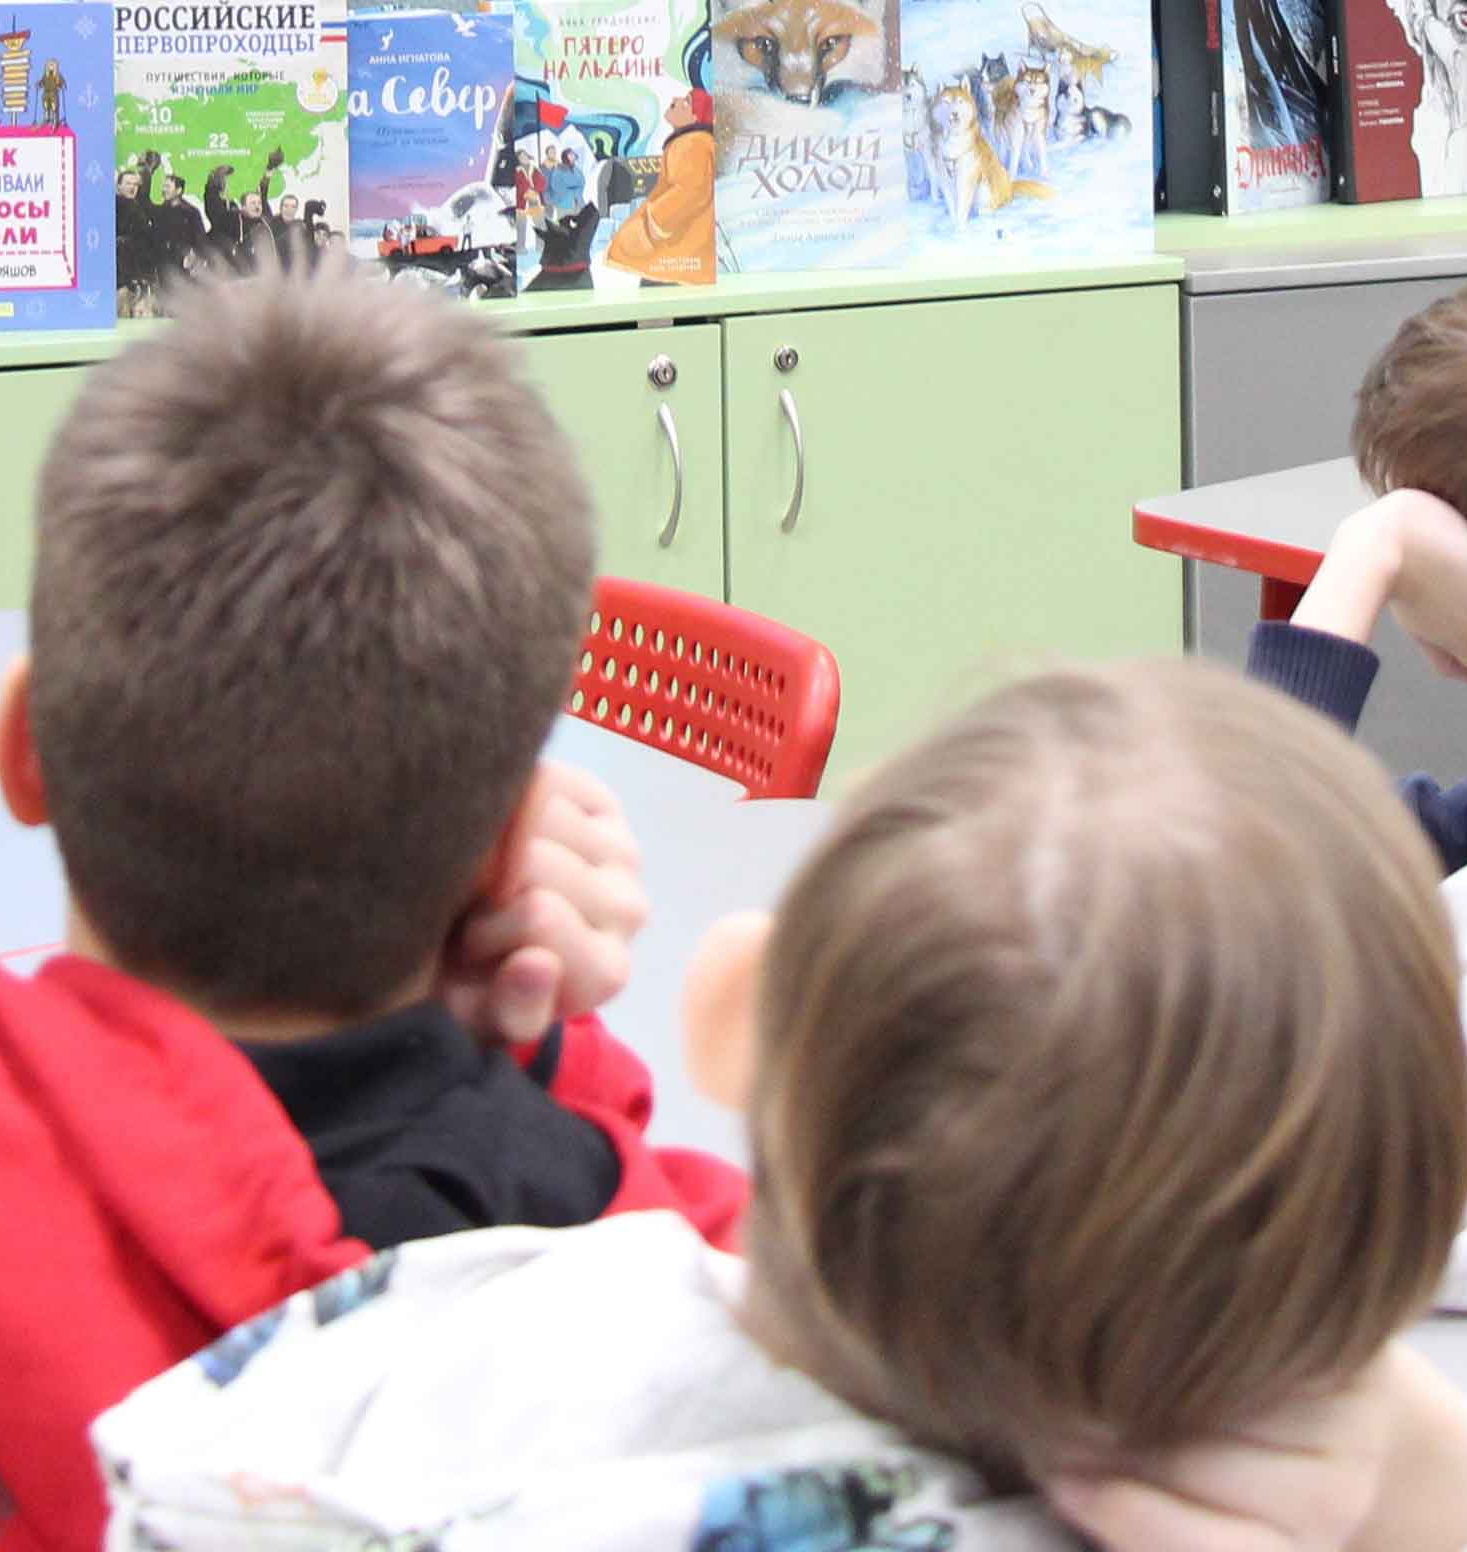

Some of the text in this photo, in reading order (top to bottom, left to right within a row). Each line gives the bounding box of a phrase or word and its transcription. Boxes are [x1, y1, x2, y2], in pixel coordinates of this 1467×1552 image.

[114, 0, 317, 32] РОССИЙСКИЕ
[116, 33, 316, 57] ПЕРВОПРОХОДЦЫ
[563, 34, 645, 57] ПЯТЕРО
[368, 51, 452, 65] АННА ИГНАТОВА
[543, 56, 666, 81] НА ЛЬДИНЕ
[145, 68, 286, 85] ПУТЕШЕСТВИЯ, КОТОРЫЕ
[347, 66, 497, 130] а Север
[149, 106, 172, 124] 10
[208, 132, 230, 149] 22
[737, 128, 882, 174] ДИКИЙ
[750, 162, 882, 200] ХОЛОД
